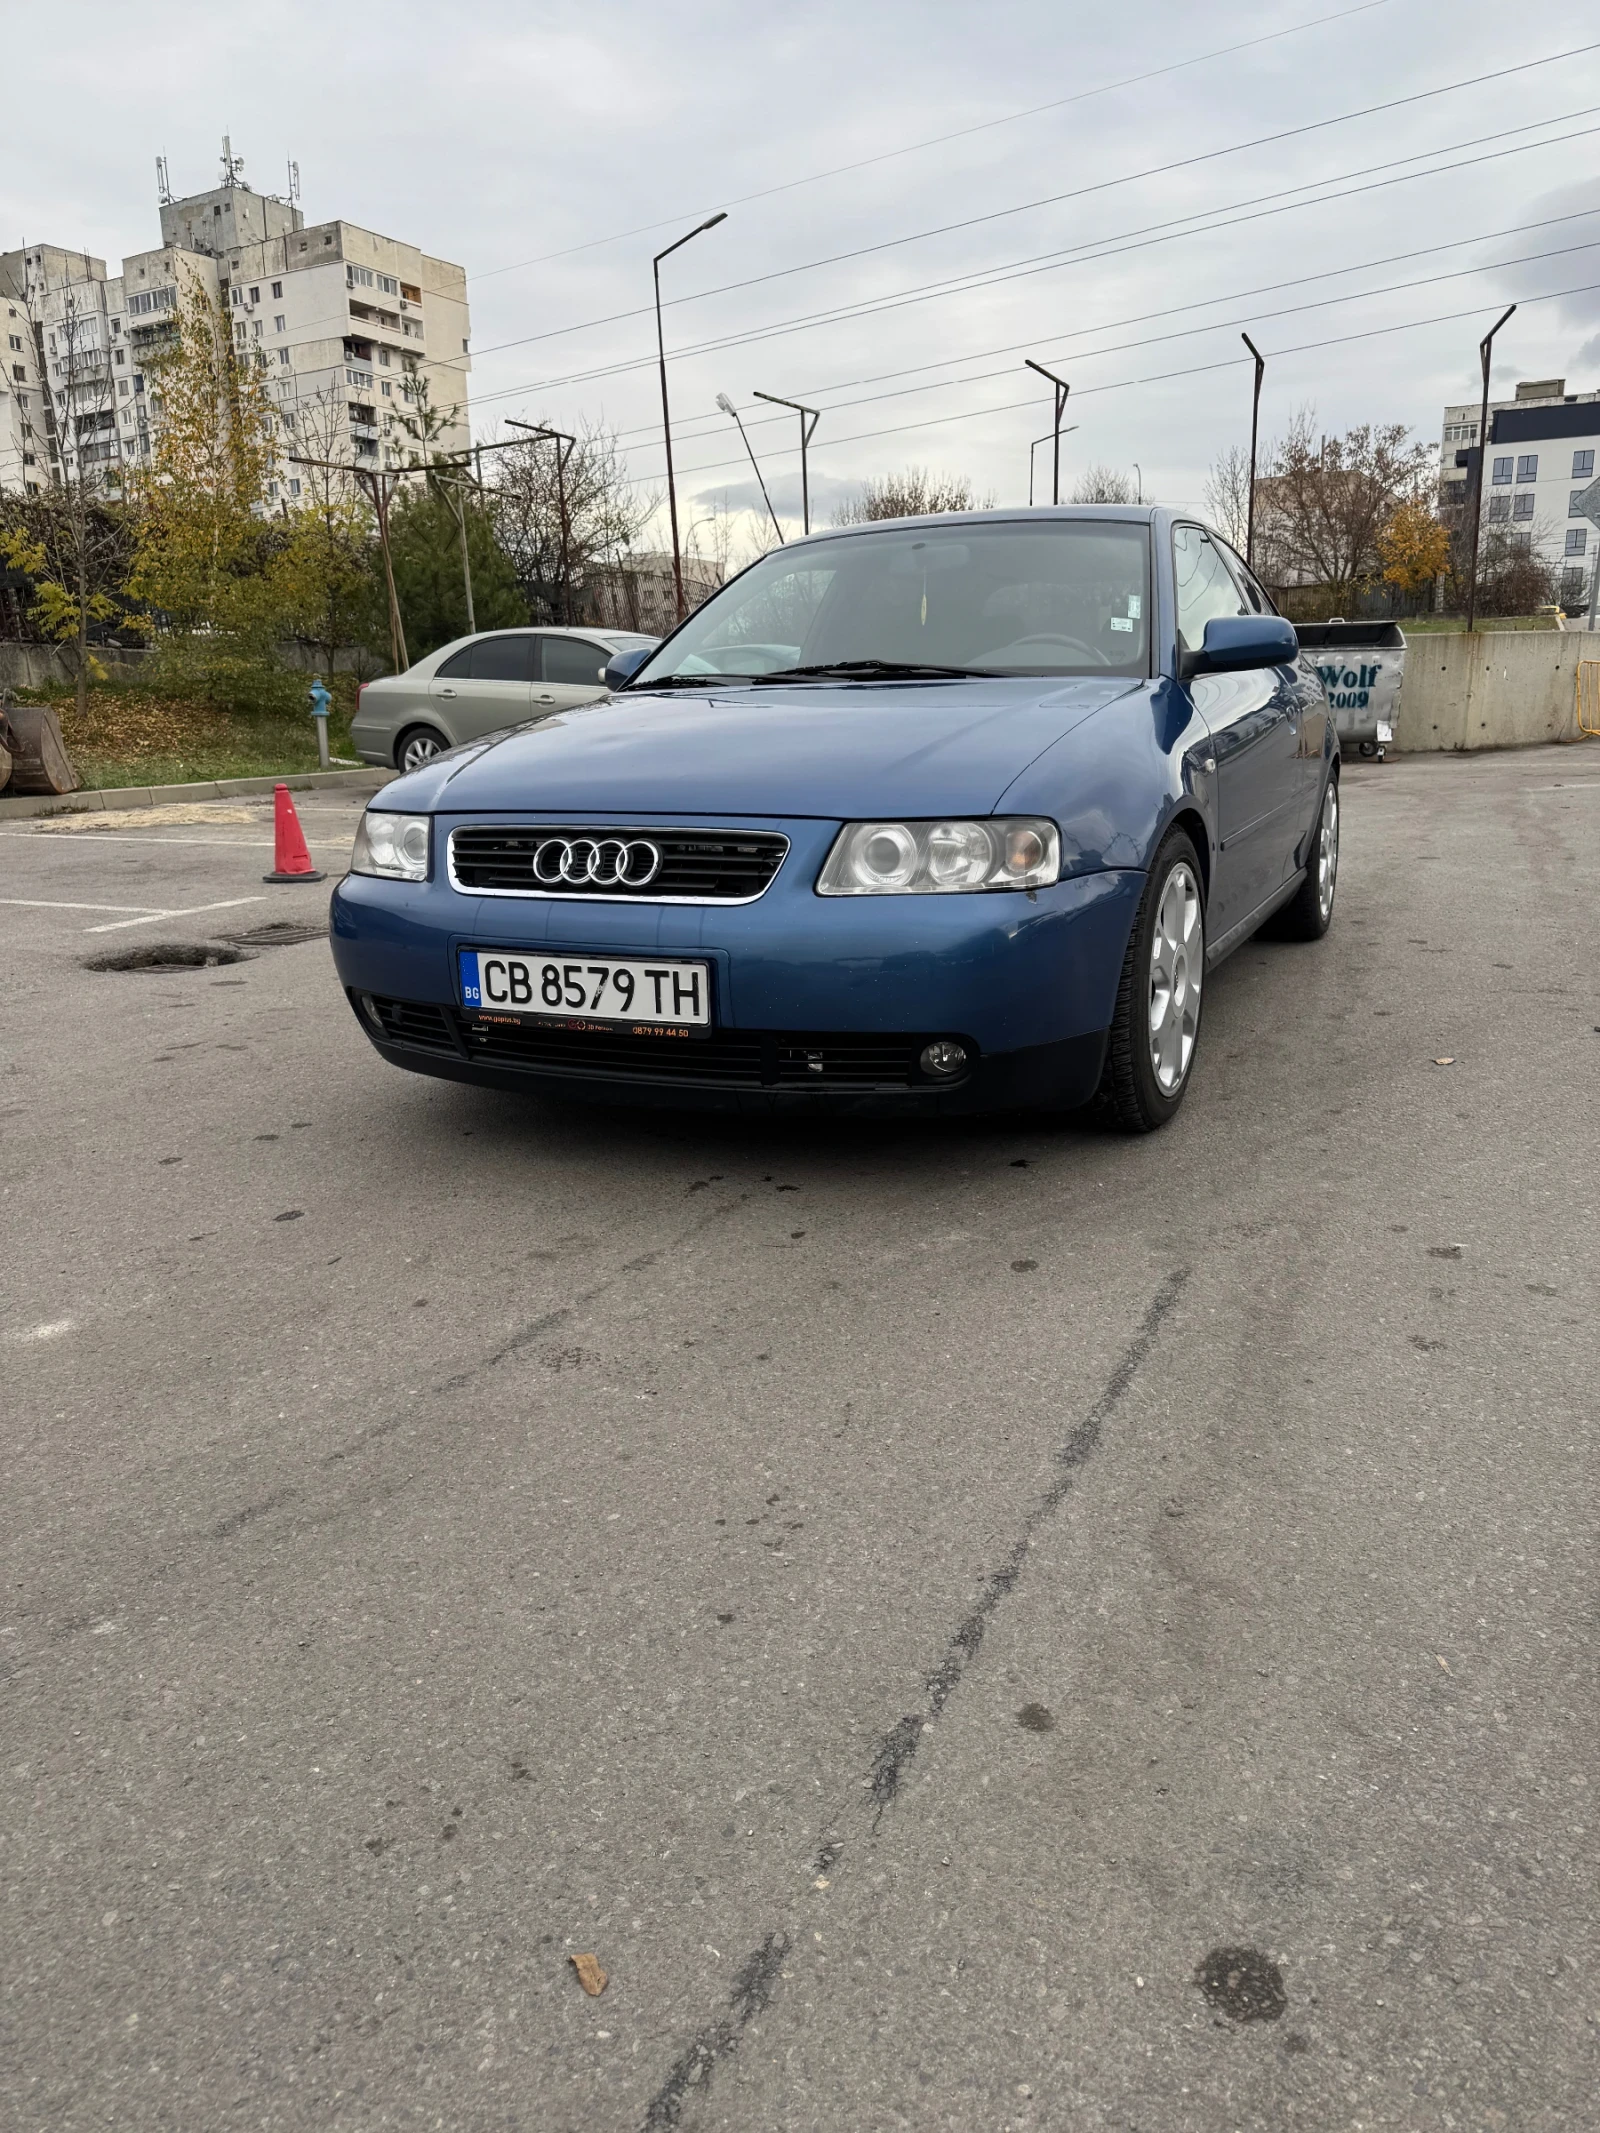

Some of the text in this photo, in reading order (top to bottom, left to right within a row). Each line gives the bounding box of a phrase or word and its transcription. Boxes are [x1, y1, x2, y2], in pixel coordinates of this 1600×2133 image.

[1315, 664, 1383, 688] Wolf
[464, 986, 480, 999] BG
[485, 960, 700, 1016] CB 8579 TH
[632, 1026, 689, 1038] 0879 99 44 50
